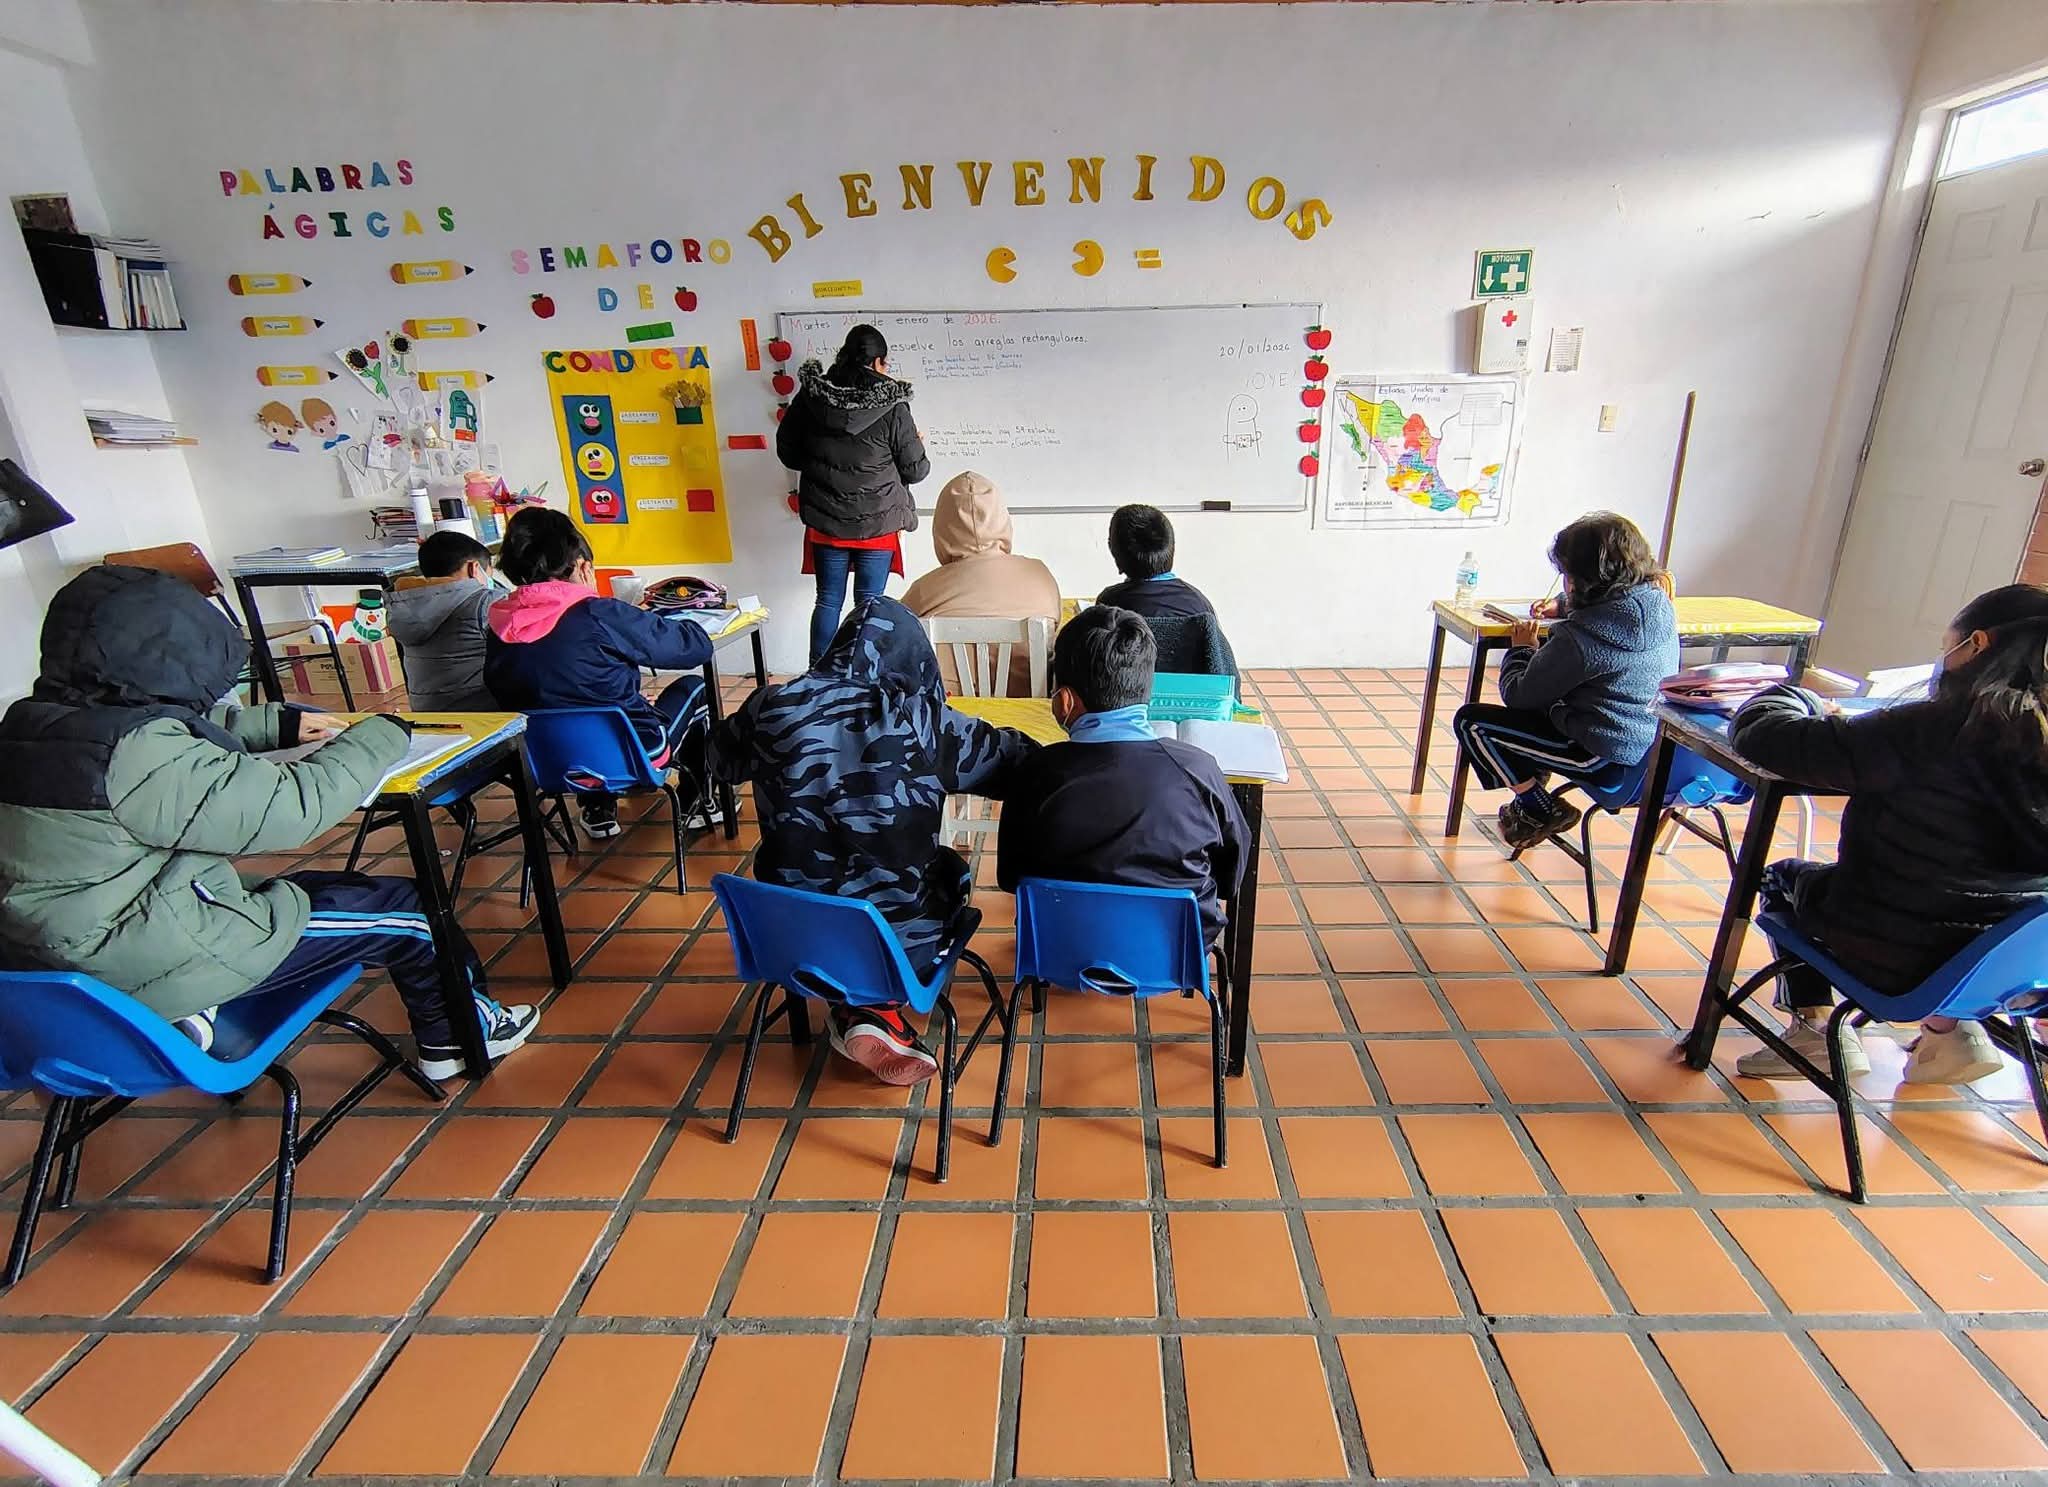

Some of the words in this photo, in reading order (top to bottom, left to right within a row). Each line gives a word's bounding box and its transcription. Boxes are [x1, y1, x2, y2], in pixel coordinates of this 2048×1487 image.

[219, 159, 414, 197] PALABRAS
[748, 154, 1333, 263] BIENVENIDOS
[510, 238, 733, 275] SEMAFORO
[597, 284, 655, 312] DE
[791, 317, 832, 332] Martes
[842, 314, 859, 326] 20
[870, 314, 884, 327] de
[895, 316, 929, 326] enero
[889, 336, 935, 352] esuelve
[947, 329, 965, 347] los
